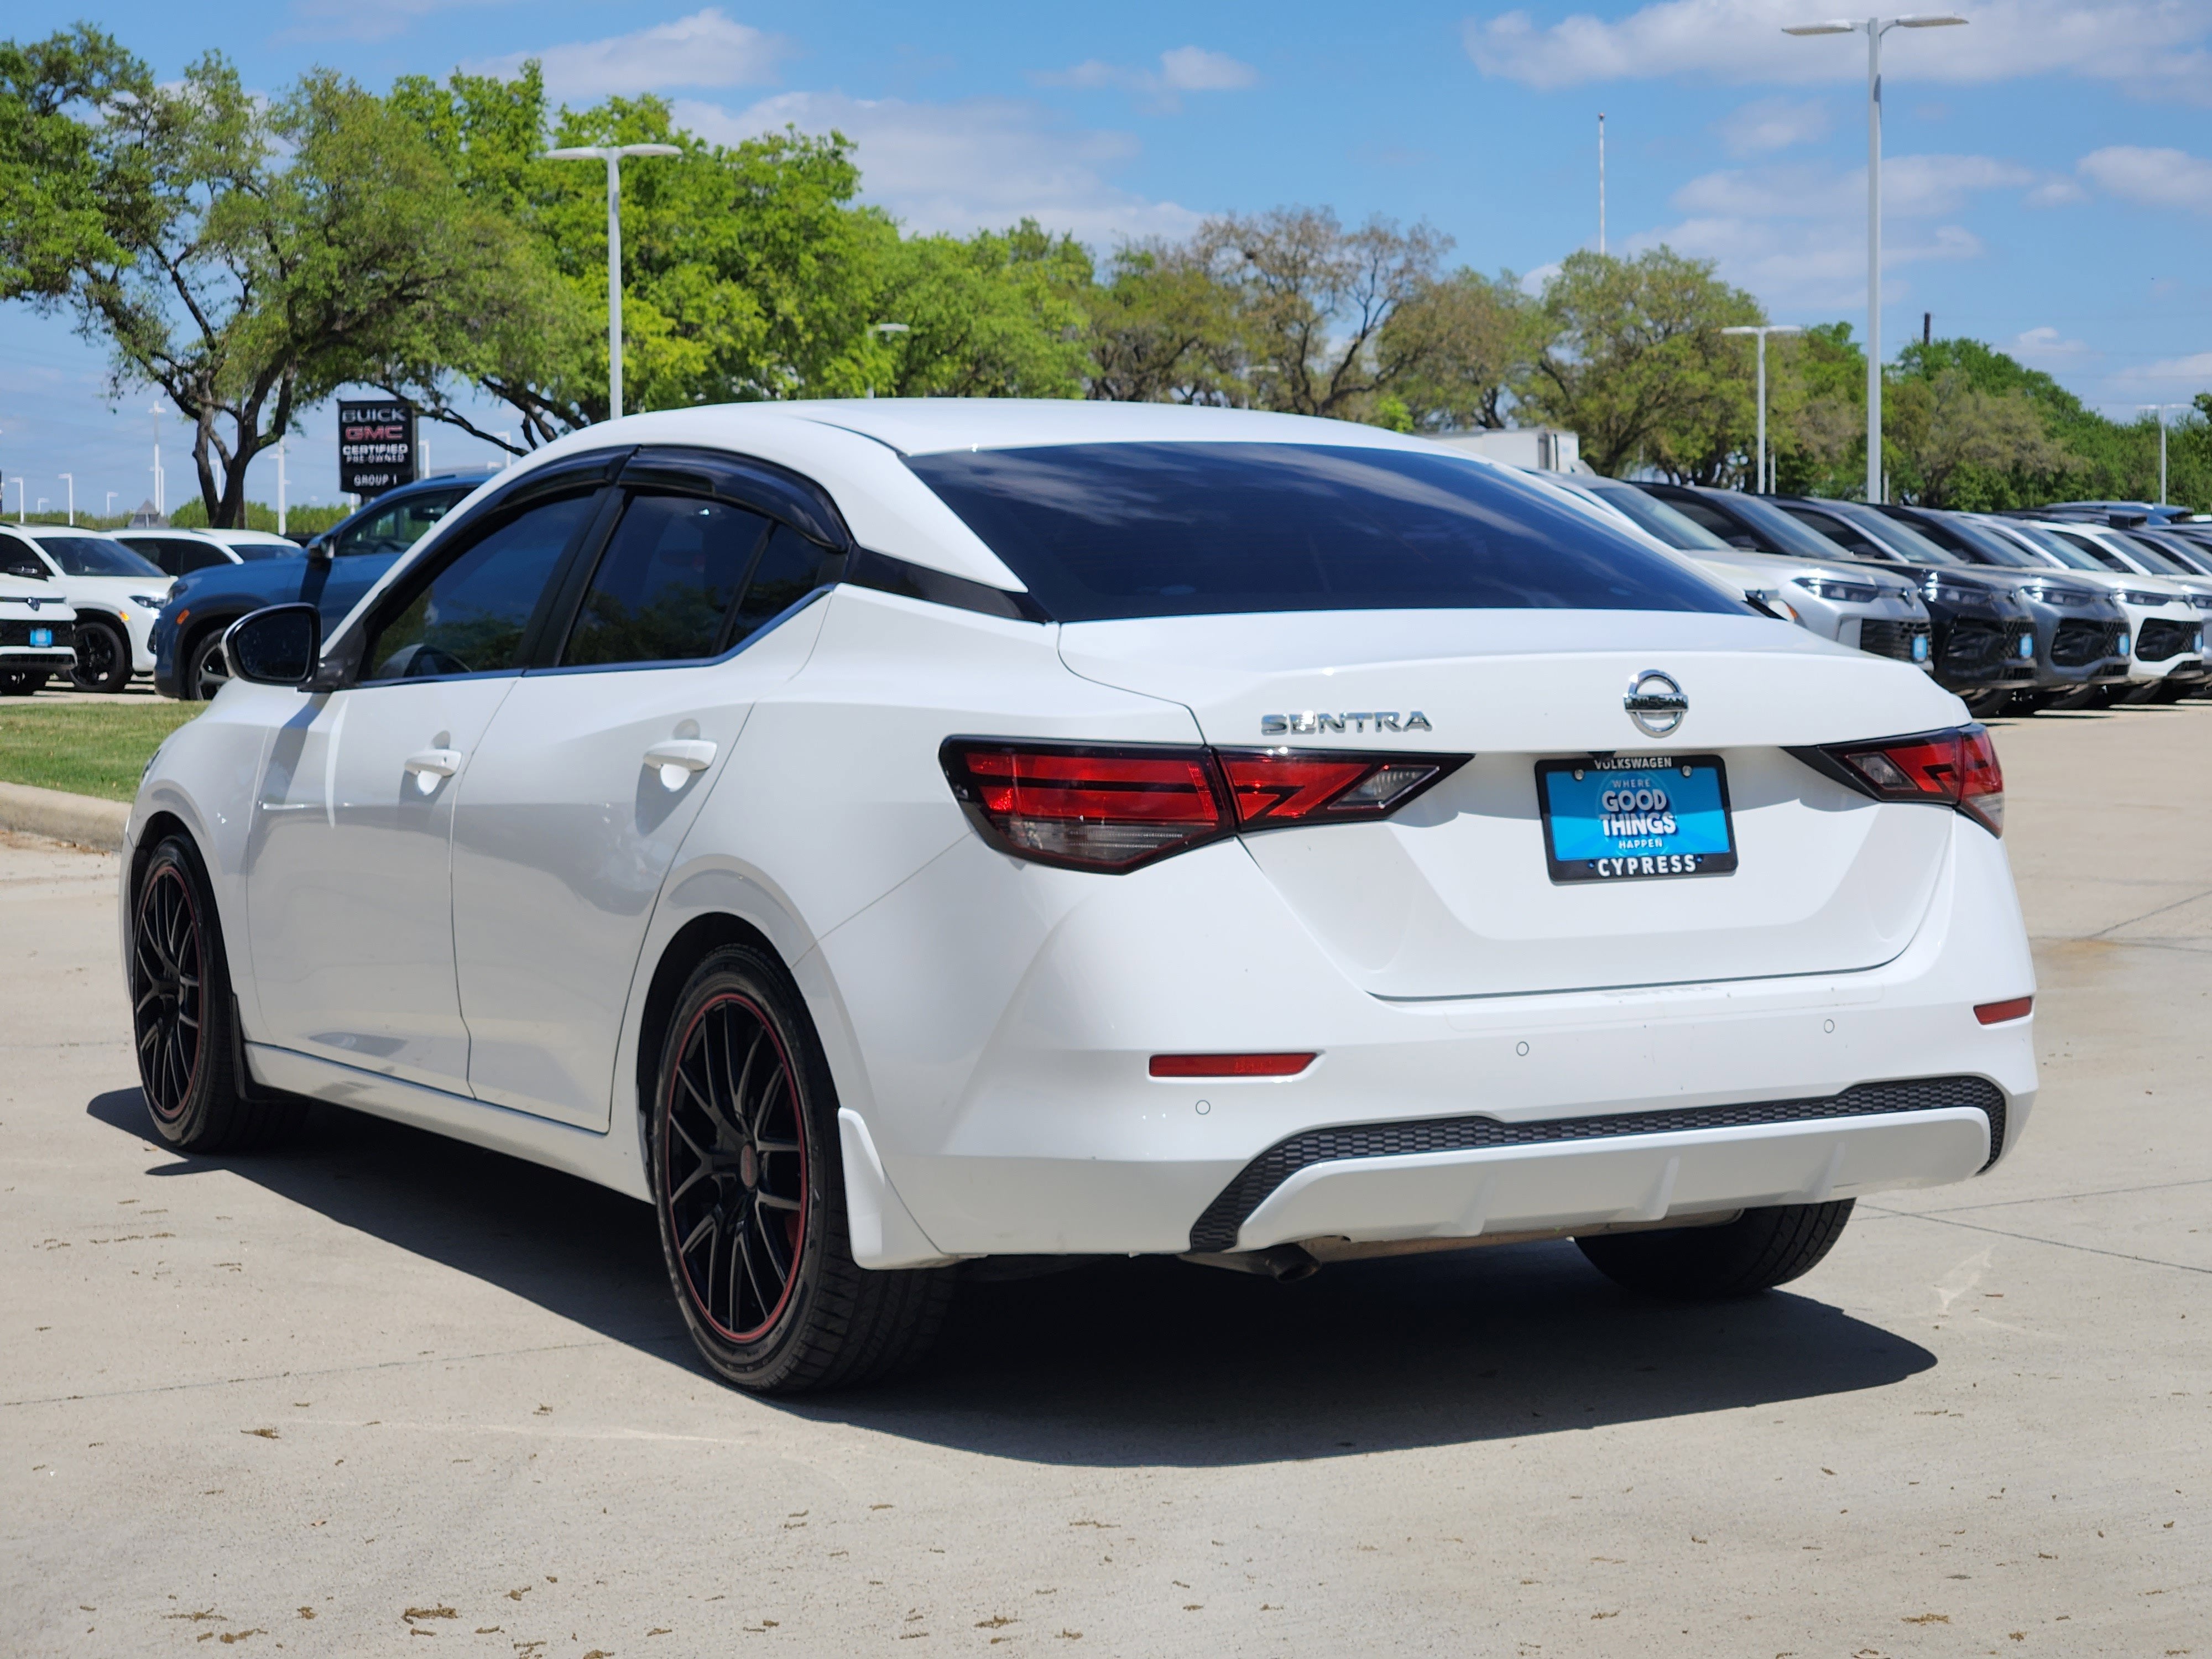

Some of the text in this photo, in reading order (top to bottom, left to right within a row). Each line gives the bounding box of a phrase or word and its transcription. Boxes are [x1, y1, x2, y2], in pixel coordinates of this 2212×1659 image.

[345, 426, 403, 440] GMC
[342, 444, 408, 455] CERTIFIED
[354, 474, 388, 487] GROUP
[1261, 711, 1432, 736] SENTRA
[1594, 757, 1672, 770] VOLKSWAGEN
[1612, 779, 1651, 788] WHERE
[1601, 789, 1667, 812] GOOD
[1599, 812, 1676, 836] THINGS
[1618, 838, 1663, 849] HAPPEN
[1597, 854, 1696, 877] CYPRESS
